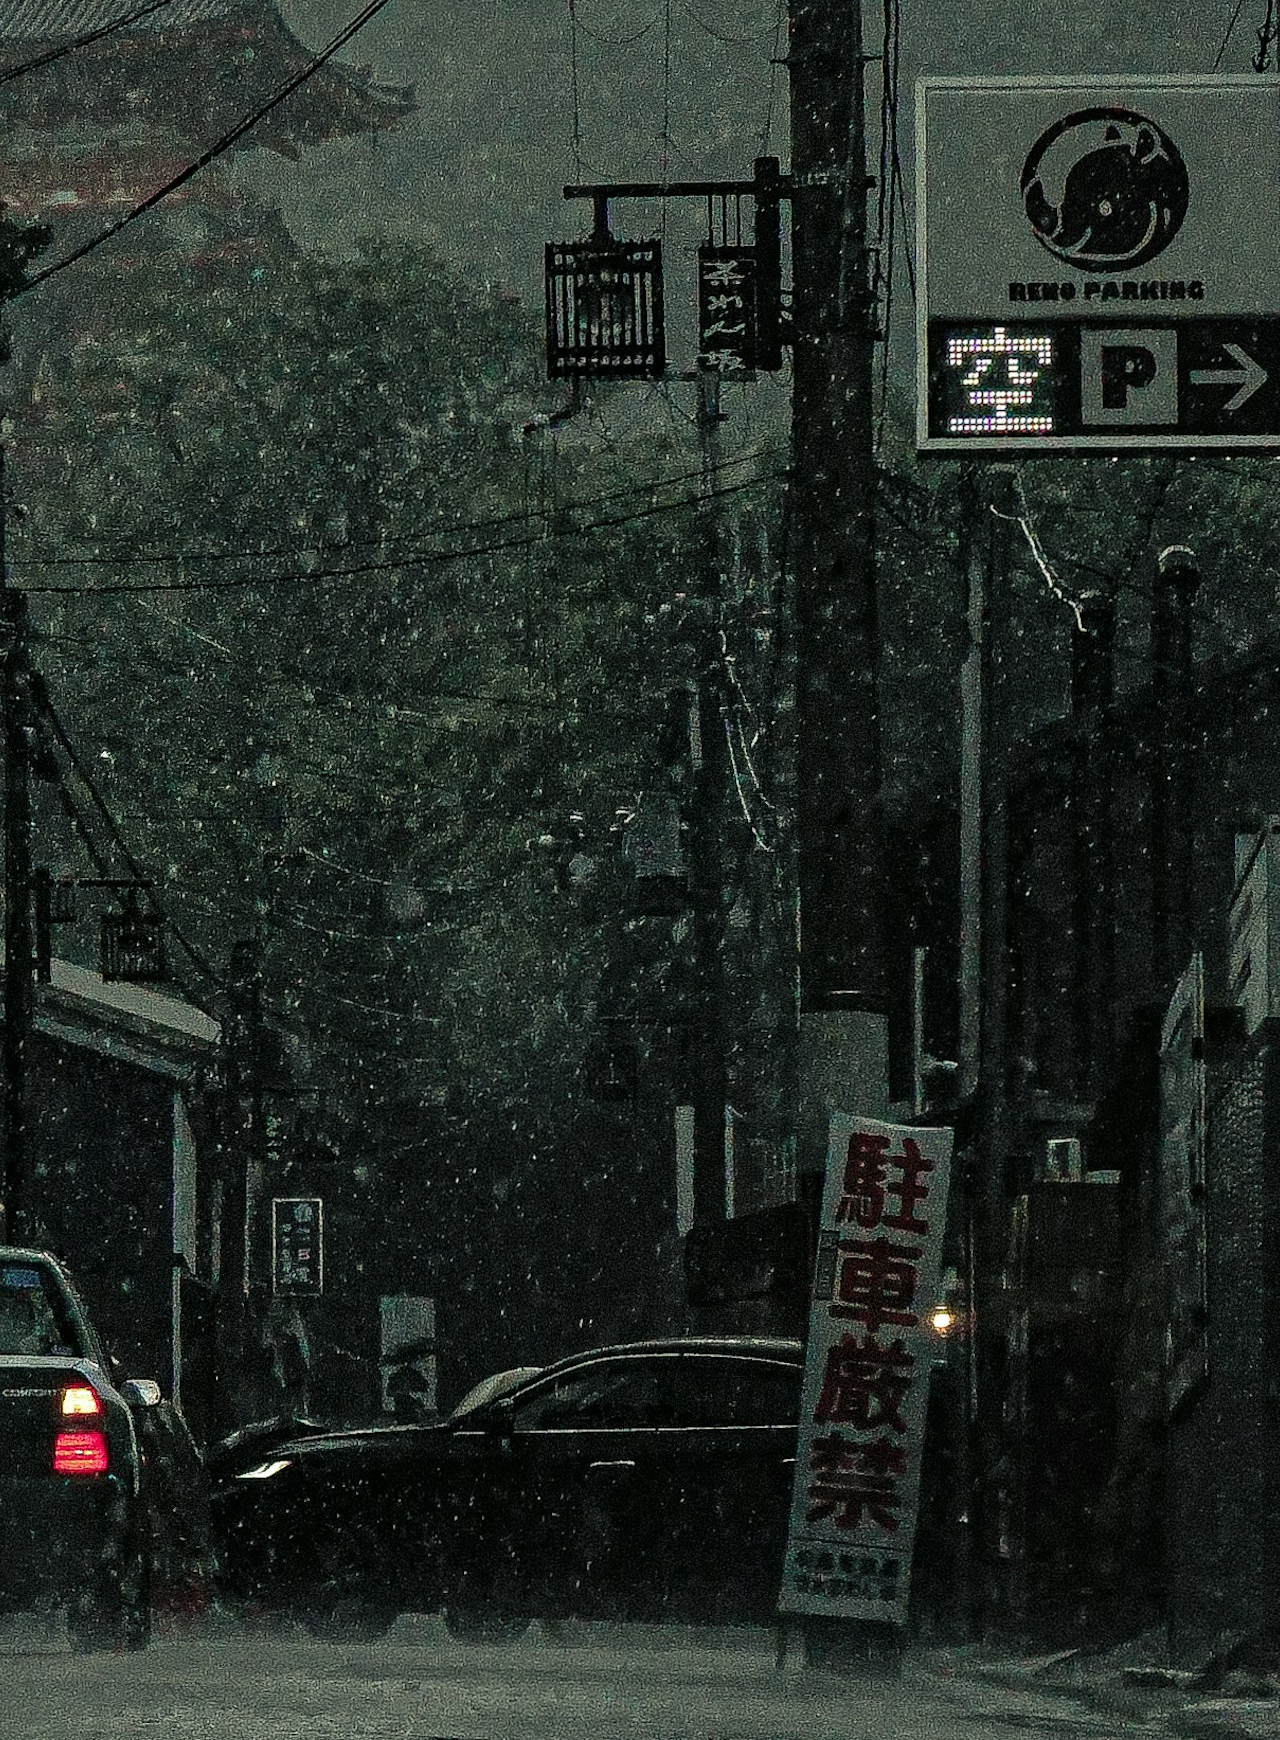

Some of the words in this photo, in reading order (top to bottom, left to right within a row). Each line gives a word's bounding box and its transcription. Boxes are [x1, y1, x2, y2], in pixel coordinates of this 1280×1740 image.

[1084, 280, 1205, 302] PARKING
[948, 326, 1054, 432] 空
[1101, 344, 1158, 410] P
[806, 1132, 932, 1531] 駐車厳禁
